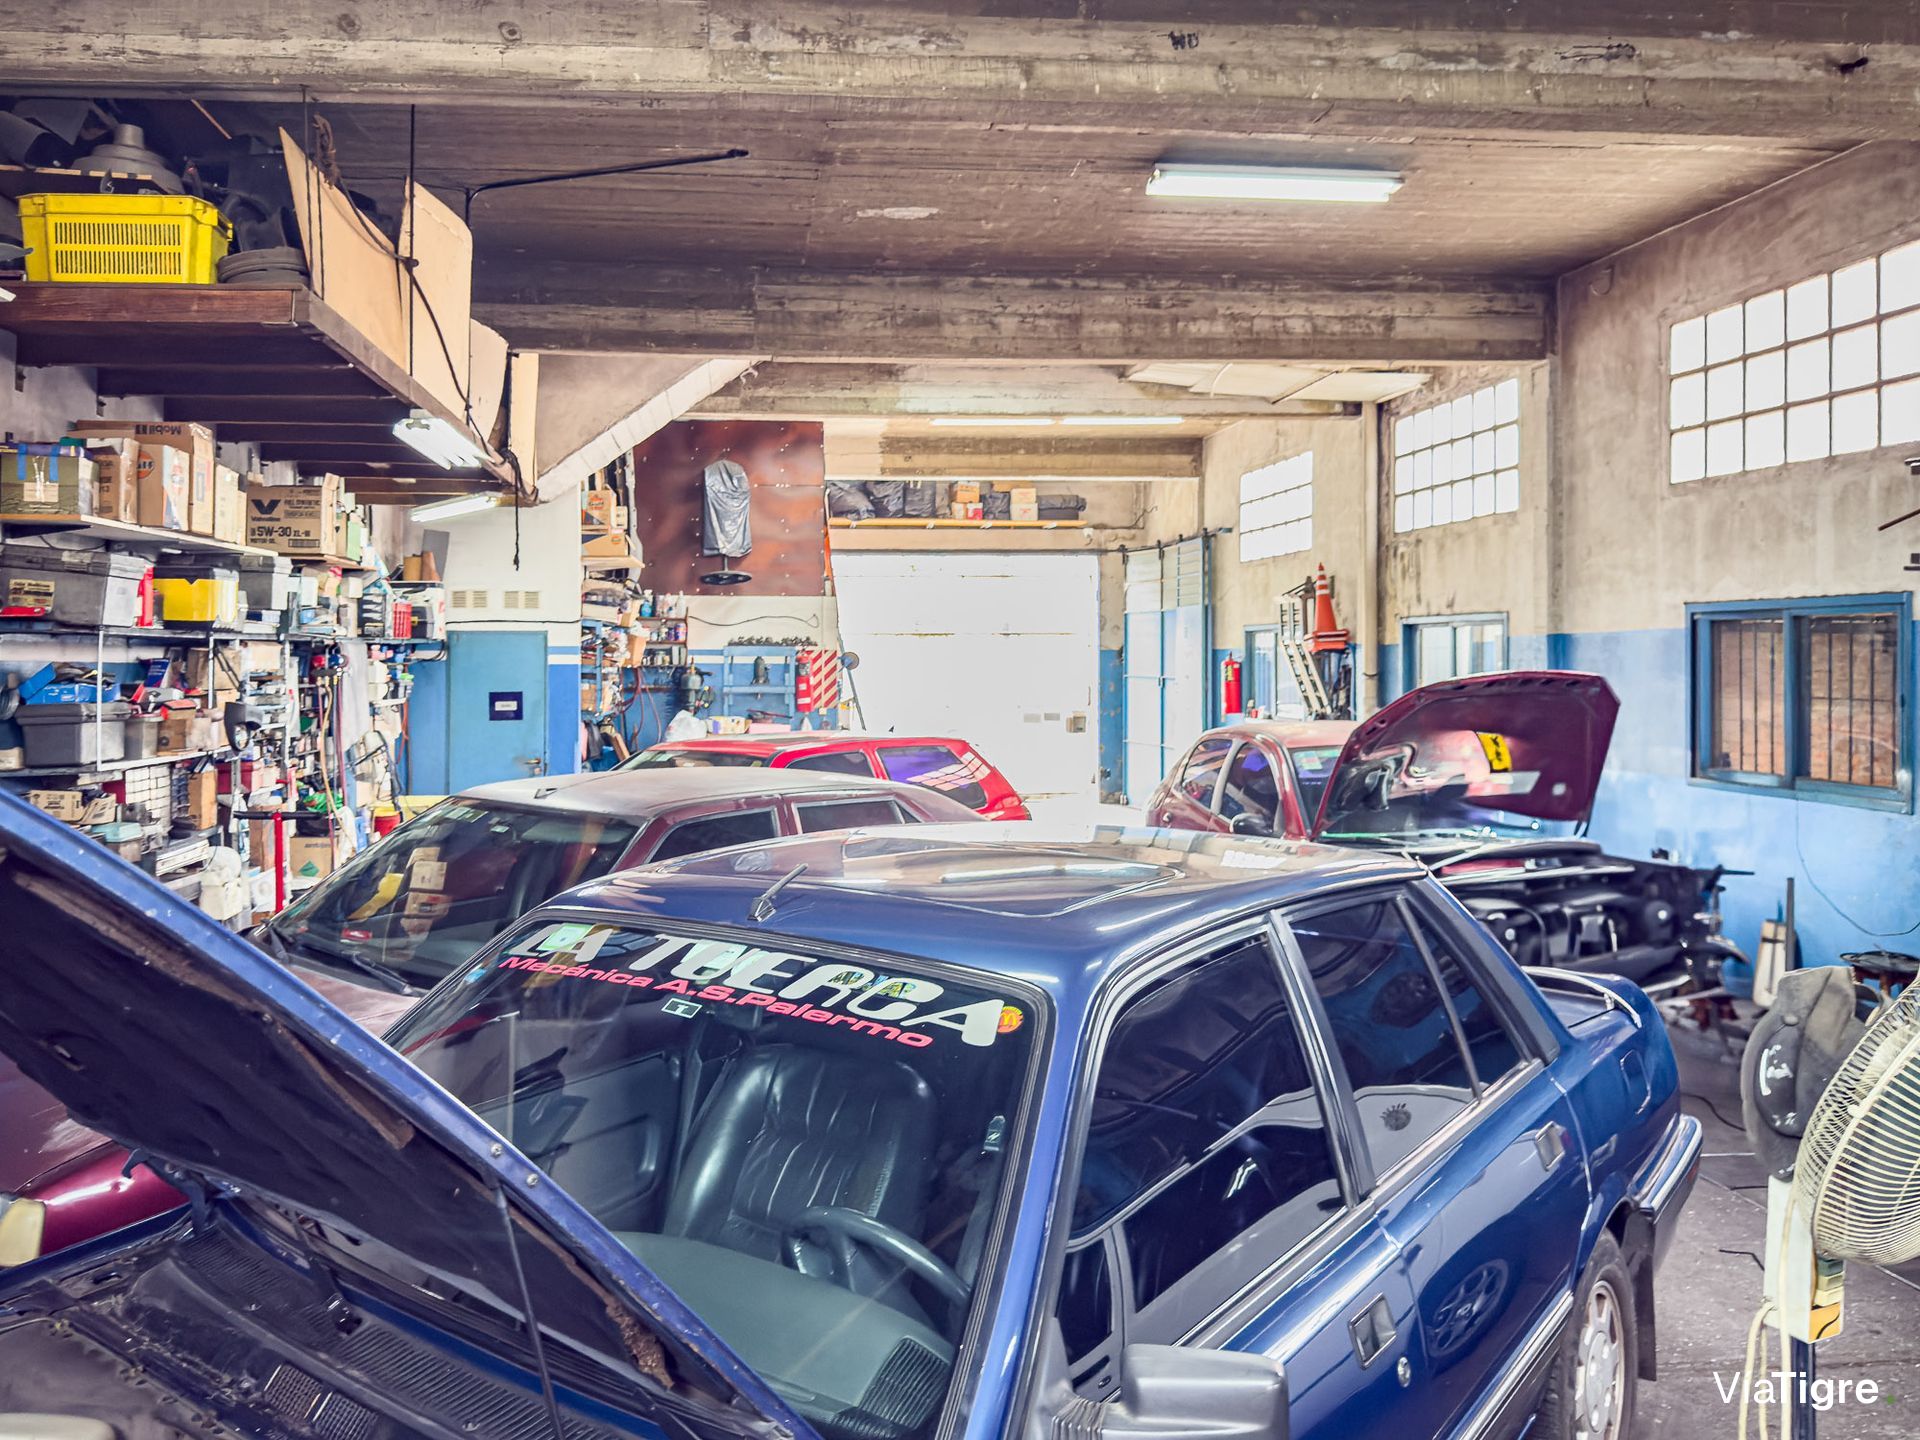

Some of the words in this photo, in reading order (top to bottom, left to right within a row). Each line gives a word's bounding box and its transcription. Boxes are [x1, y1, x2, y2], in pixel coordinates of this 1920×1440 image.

[257, 526, 292, 537] 5W-30
[498, 956, 654, 988] Mecánica
[508, 923, 614, 963] LA
[628, 933, 1004, 1047] TUERCA
